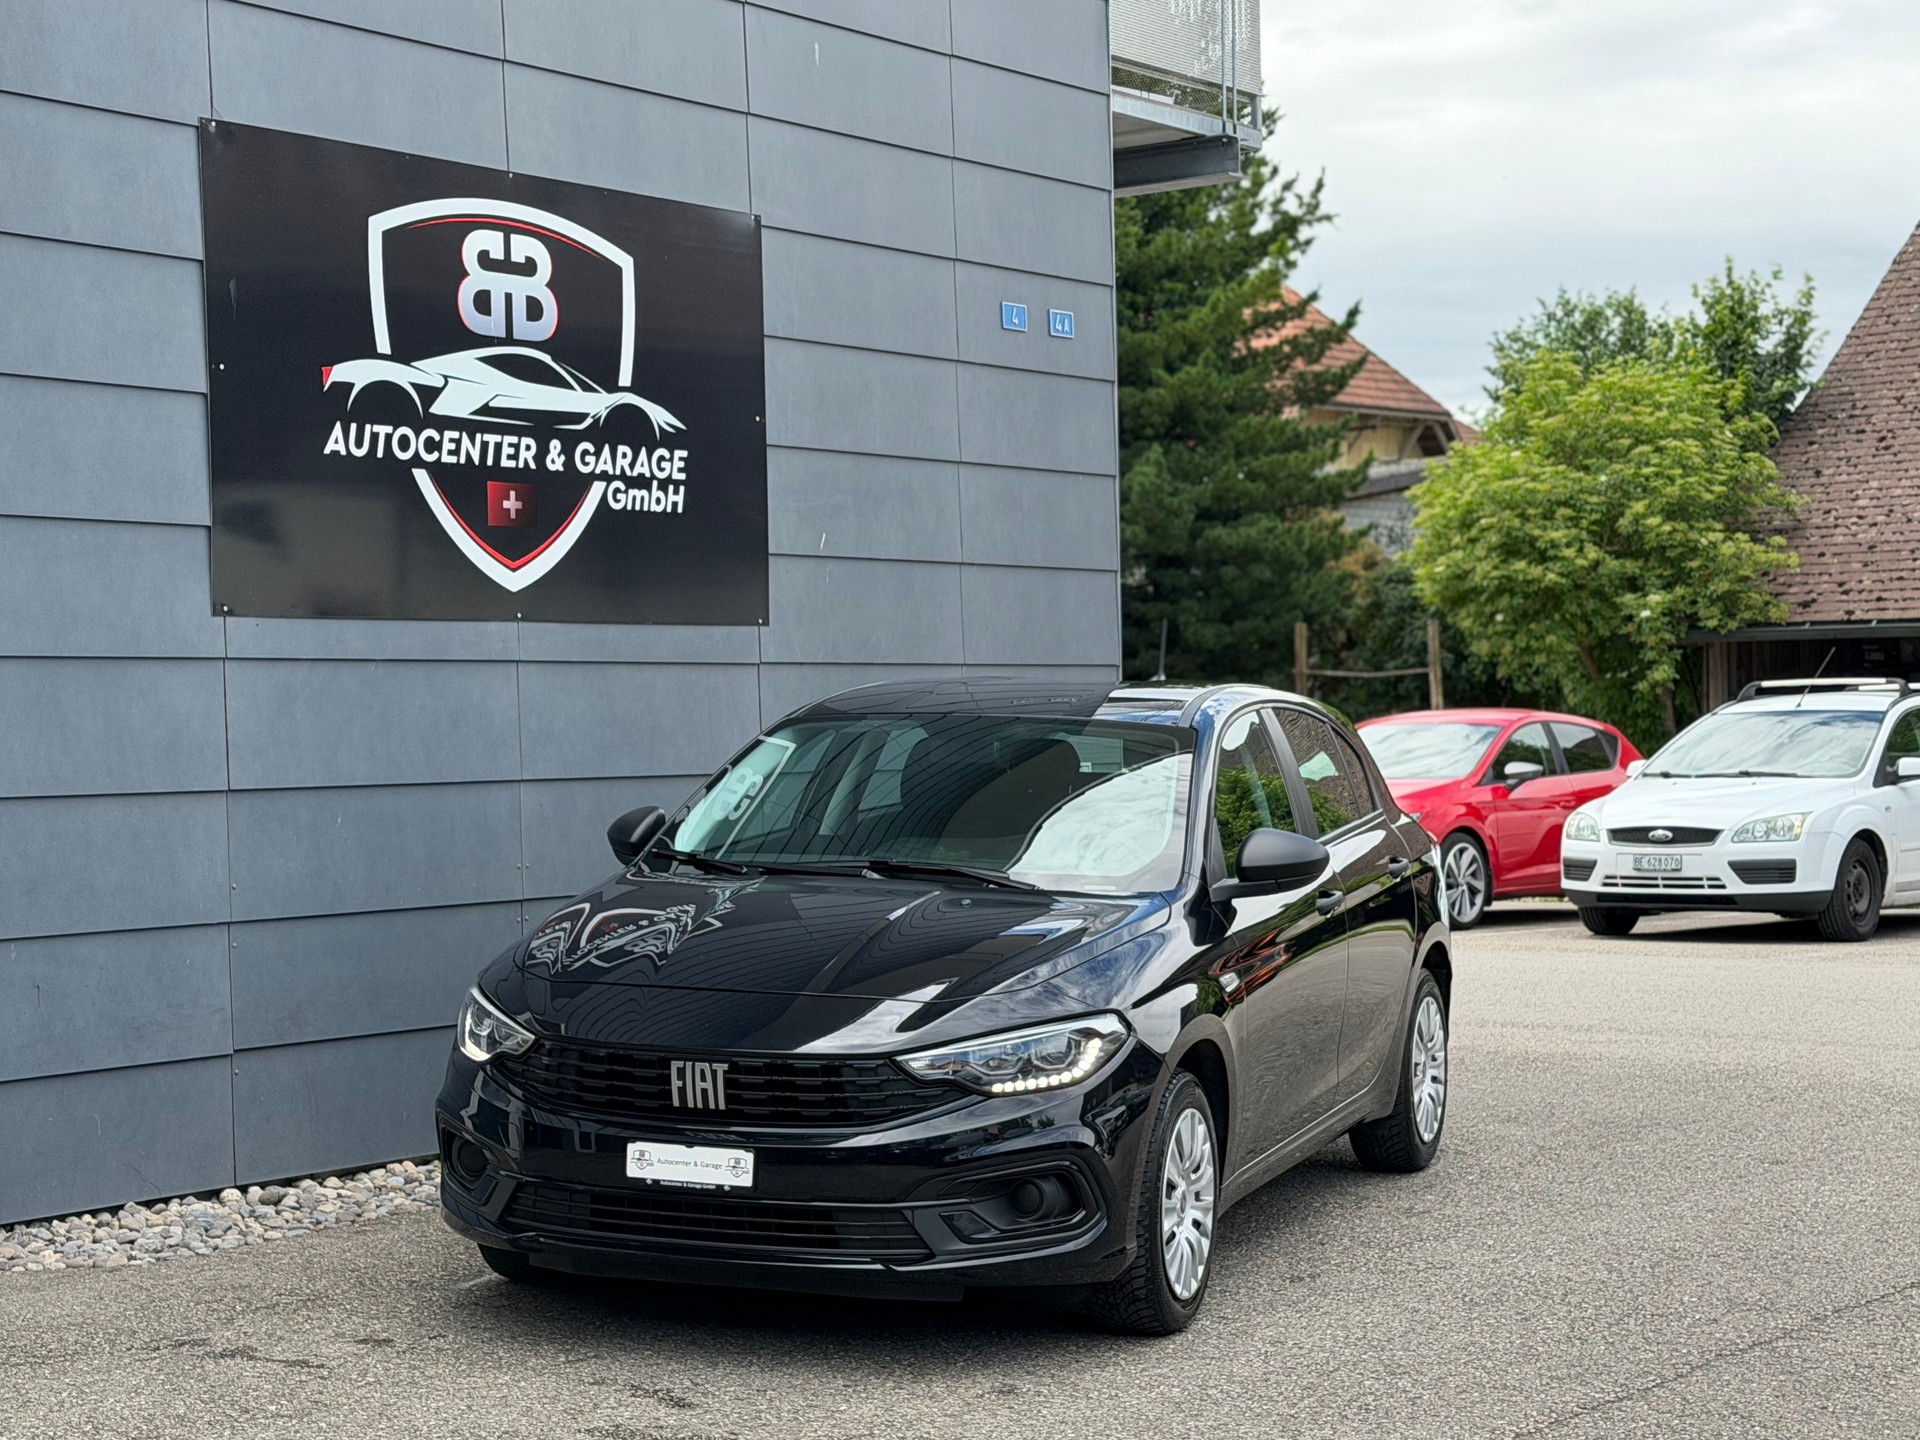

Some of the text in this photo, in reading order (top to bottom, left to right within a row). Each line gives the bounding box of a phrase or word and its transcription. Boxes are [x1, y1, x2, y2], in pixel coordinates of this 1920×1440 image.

[1012, 307, 1019, 325] 4
[1055, 314, 1070, 333] 4A
[323, 420, 689, 481] AUTOCENTER & GARAGE
[606, 481, 685, 514] GmbH
[1634, 856, 1645, 868] BE
[670, 1060, 729, 1110] FIAT
[657, 1158, 692, 1167] Autocenter
[693, 1160, 698, 1168] &
[700, 1161, 723, 1171] Garage
